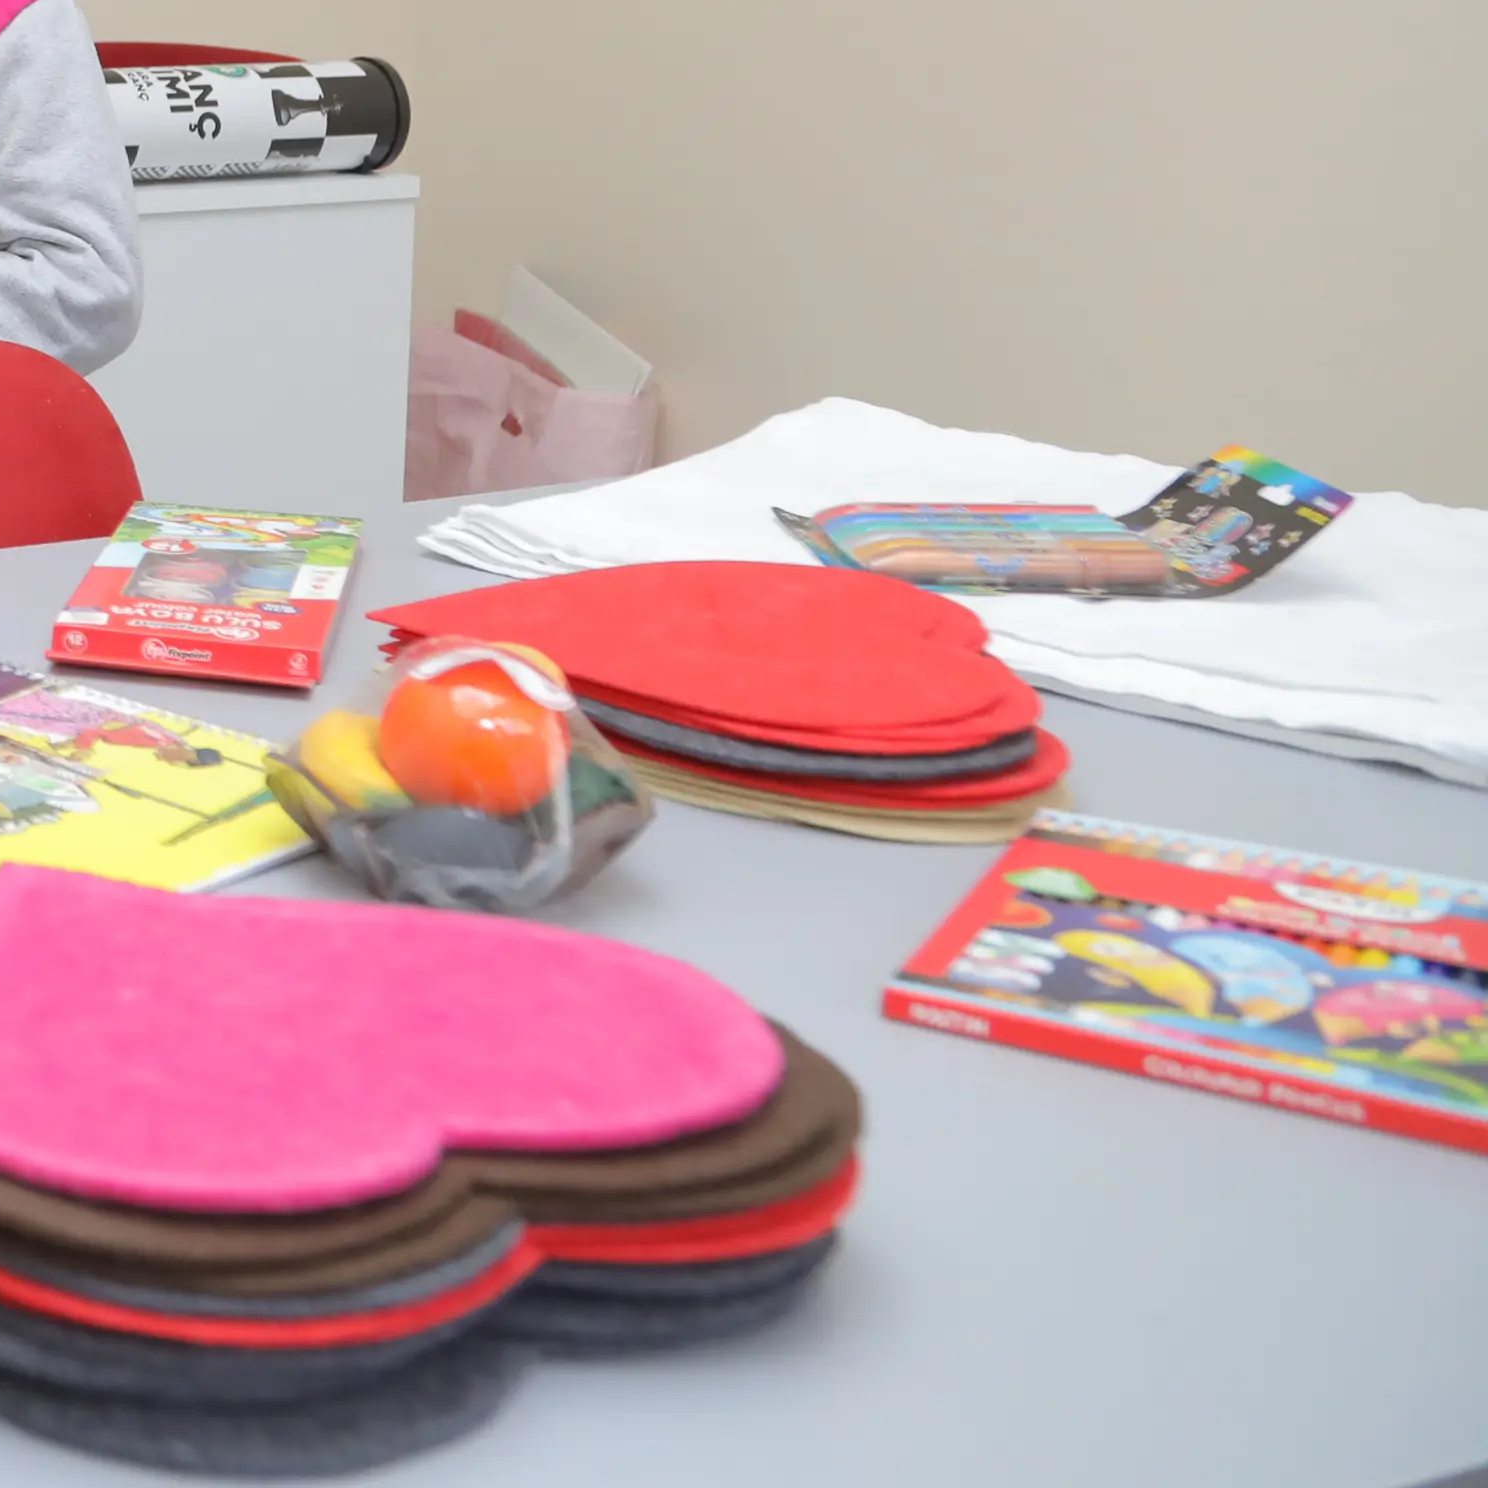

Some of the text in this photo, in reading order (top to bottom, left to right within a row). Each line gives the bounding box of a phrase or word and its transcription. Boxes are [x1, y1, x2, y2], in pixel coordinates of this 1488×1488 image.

[110, 605, 282, 630] SULU BOYA
[167, 645, 211, 662] fixpoint
